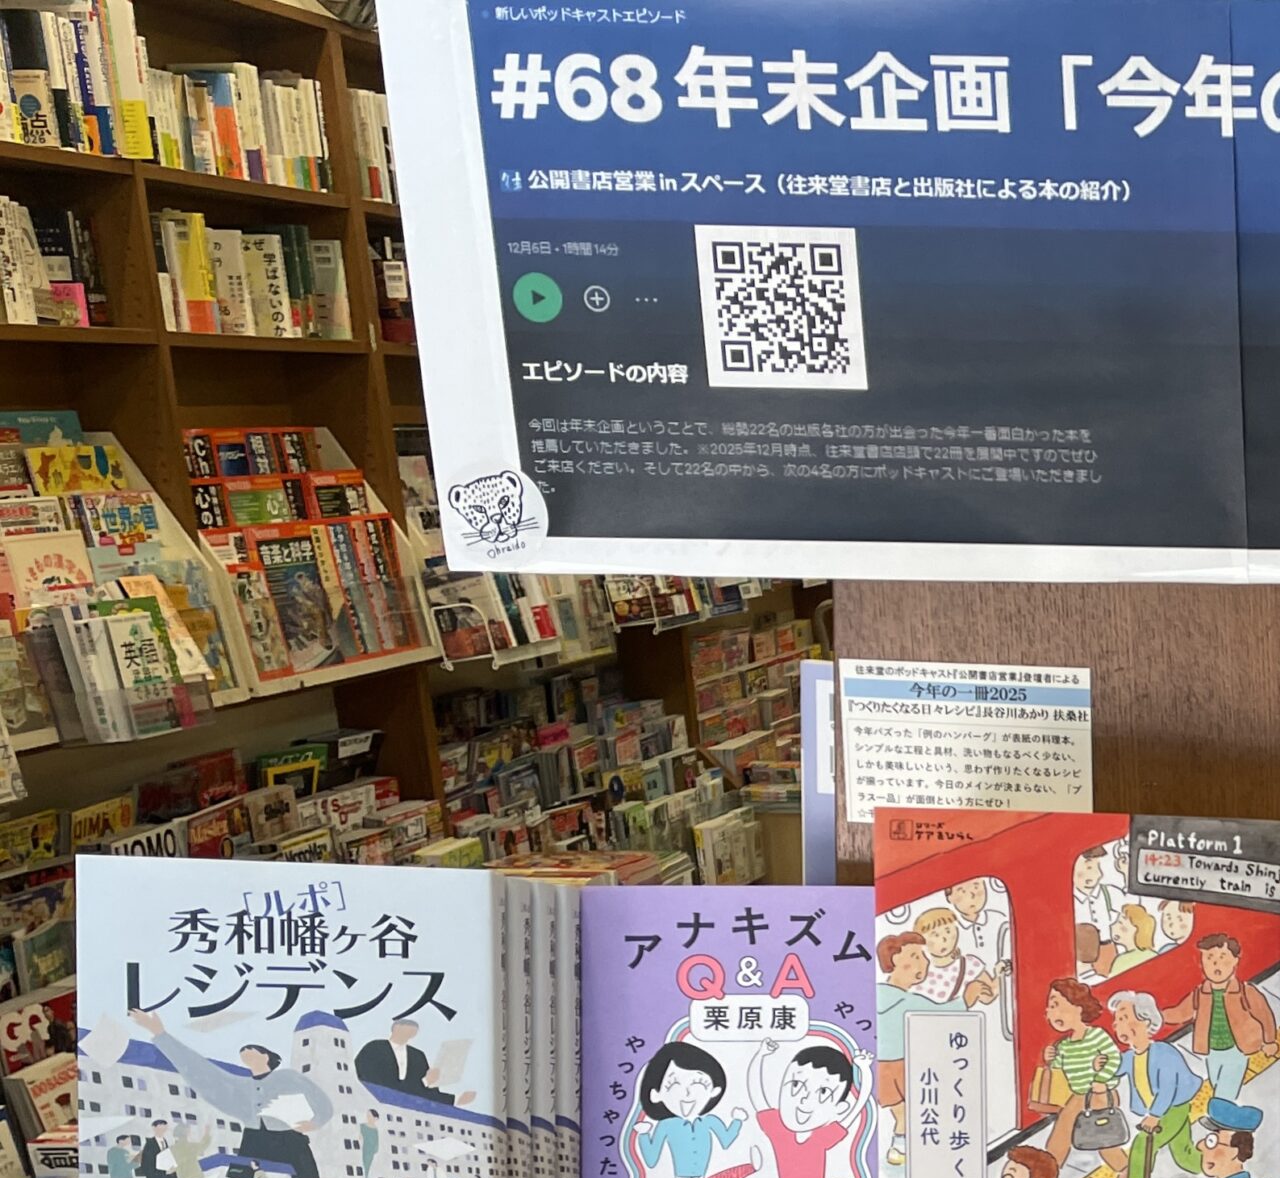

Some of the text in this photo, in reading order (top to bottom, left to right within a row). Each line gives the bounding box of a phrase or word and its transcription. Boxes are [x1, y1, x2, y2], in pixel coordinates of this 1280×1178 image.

[496, 5, 686, 24] 新しいポッドキャストエピソード
[491, 53, 663, 123] #68
[522, 359, 689, 385] エピソードの内容
[910, 683, 1027, 702] 今年の一冊2025
[1148, 830, 1243, 855] Platform 1
[1143, 871, 1276, 897] currently train is
[625, 907, 872, 969] アナキズム
[126, 959, 457, 1022] レジデンス
[703, 1005, 797, 1030] 栗原康
[920, 1067, 940, 1146] 小川公代
[948, 1030, 970, 1178] ゆっくり歩く
